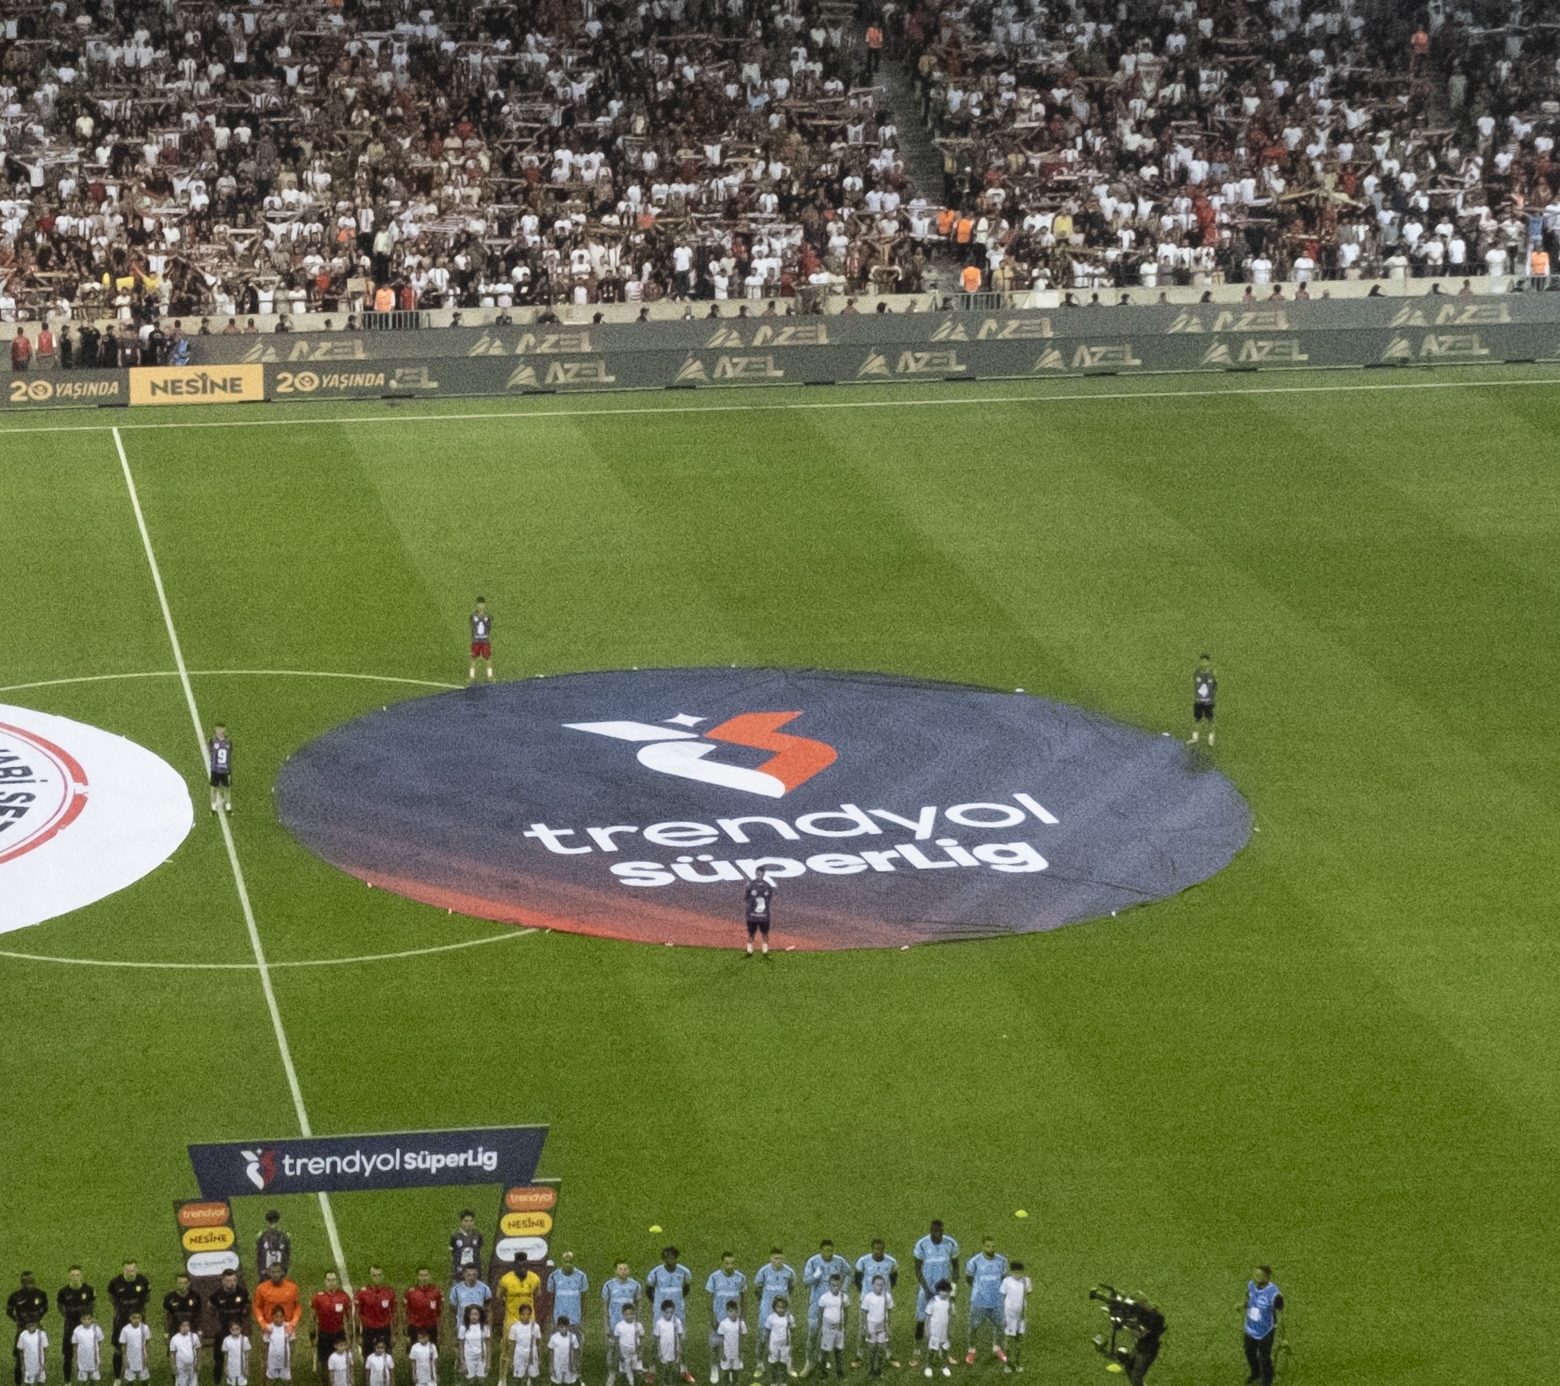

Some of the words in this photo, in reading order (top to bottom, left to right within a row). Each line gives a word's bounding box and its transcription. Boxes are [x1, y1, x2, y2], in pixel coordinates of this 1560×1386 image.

[1214, 311, 1289, 330] AZEL
[1436, 304, 1511, 324] AZEL
[753, 326, 829, 345] AZEL
[978, 318, 1054, 339] AZEL
[289, 341, 366, 360] AZEL
[516, 334, 592, 353] AZEL
[1240, 340, 1308, 361] AZEL
[1421, 335, 1489, 355] AZEL
[897, 352, 966, 372] AZEL
[1073, 346, 1141, 367] AZEL
[546, 362, 615, 384] AZEL
[714, 357, 784, 378] AZEL
[54, 379, 119, 398] YAŞINDA
[321, 370, 386, 390] YAŞINDA
[523, 793, 1060, 855] trendyol
[282, 1148, 401, 1177] trendyol
